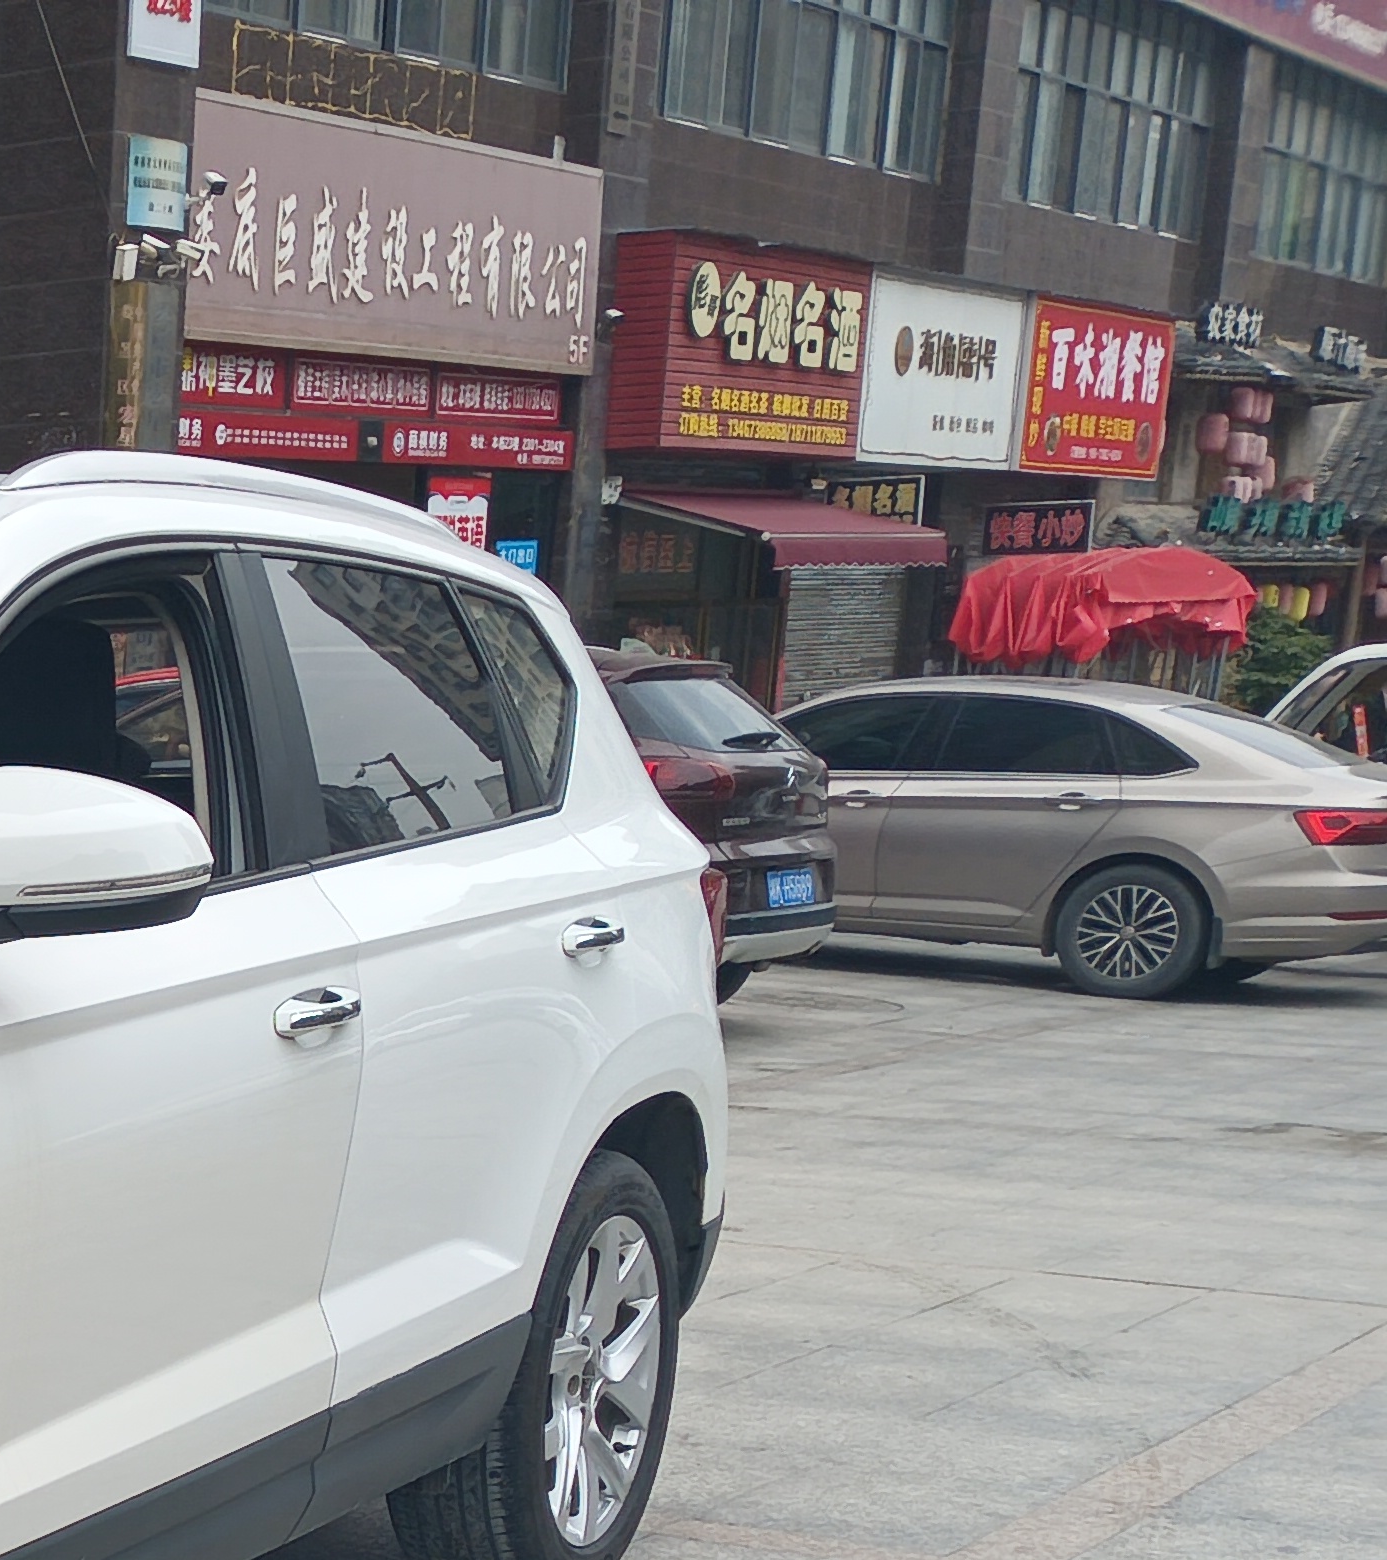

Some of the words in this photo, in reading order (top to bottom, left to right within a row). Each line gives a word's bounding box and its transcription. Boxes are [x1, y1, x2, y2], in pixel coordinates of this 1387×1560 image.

[723, 270, 864, 374] 名烟名酒
[568, 335, 589, 364] 5F
[990, 508, 1085, 550] 快餐小炒
